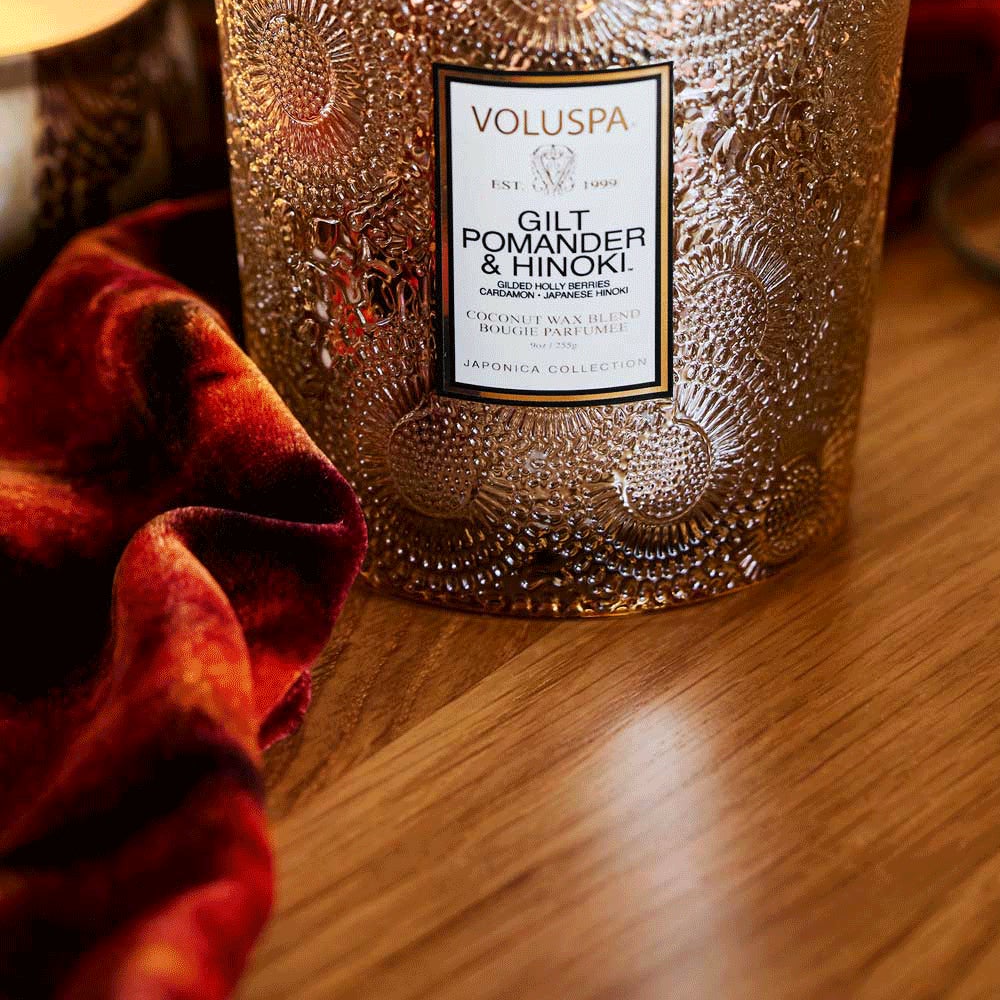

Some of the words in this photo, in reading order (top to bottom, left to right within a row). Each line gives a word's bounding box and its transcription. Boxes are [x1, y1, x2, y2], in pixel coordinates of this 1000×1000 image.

[471, 105, 629, 136] VOLUSPA
[518, 209, 590, 232] GILT
[462, 226, 646, 254] POMANDER
[481, 253, 501, 275] &
[479, 287, 535, 299] CARDAMON
[543, 290, 593, 299] JAPANESE
[595, 286, 629, 297] HINOKI
[497, 280, 532, 290] GILDED
[535, 281, 565, 291] HOLLY
[568, 279, 611, 290] BERRIES
[466, 309, 541, 325] COCONUT
[547, 314, 583, 325] WAX
[588, 308, 641, 324] BLEND
[479, 322, 540, 337] BOUGIE
[463, 359, 540, 374] JAPONICA
[548, 357, 648, 374] COLLECTION
